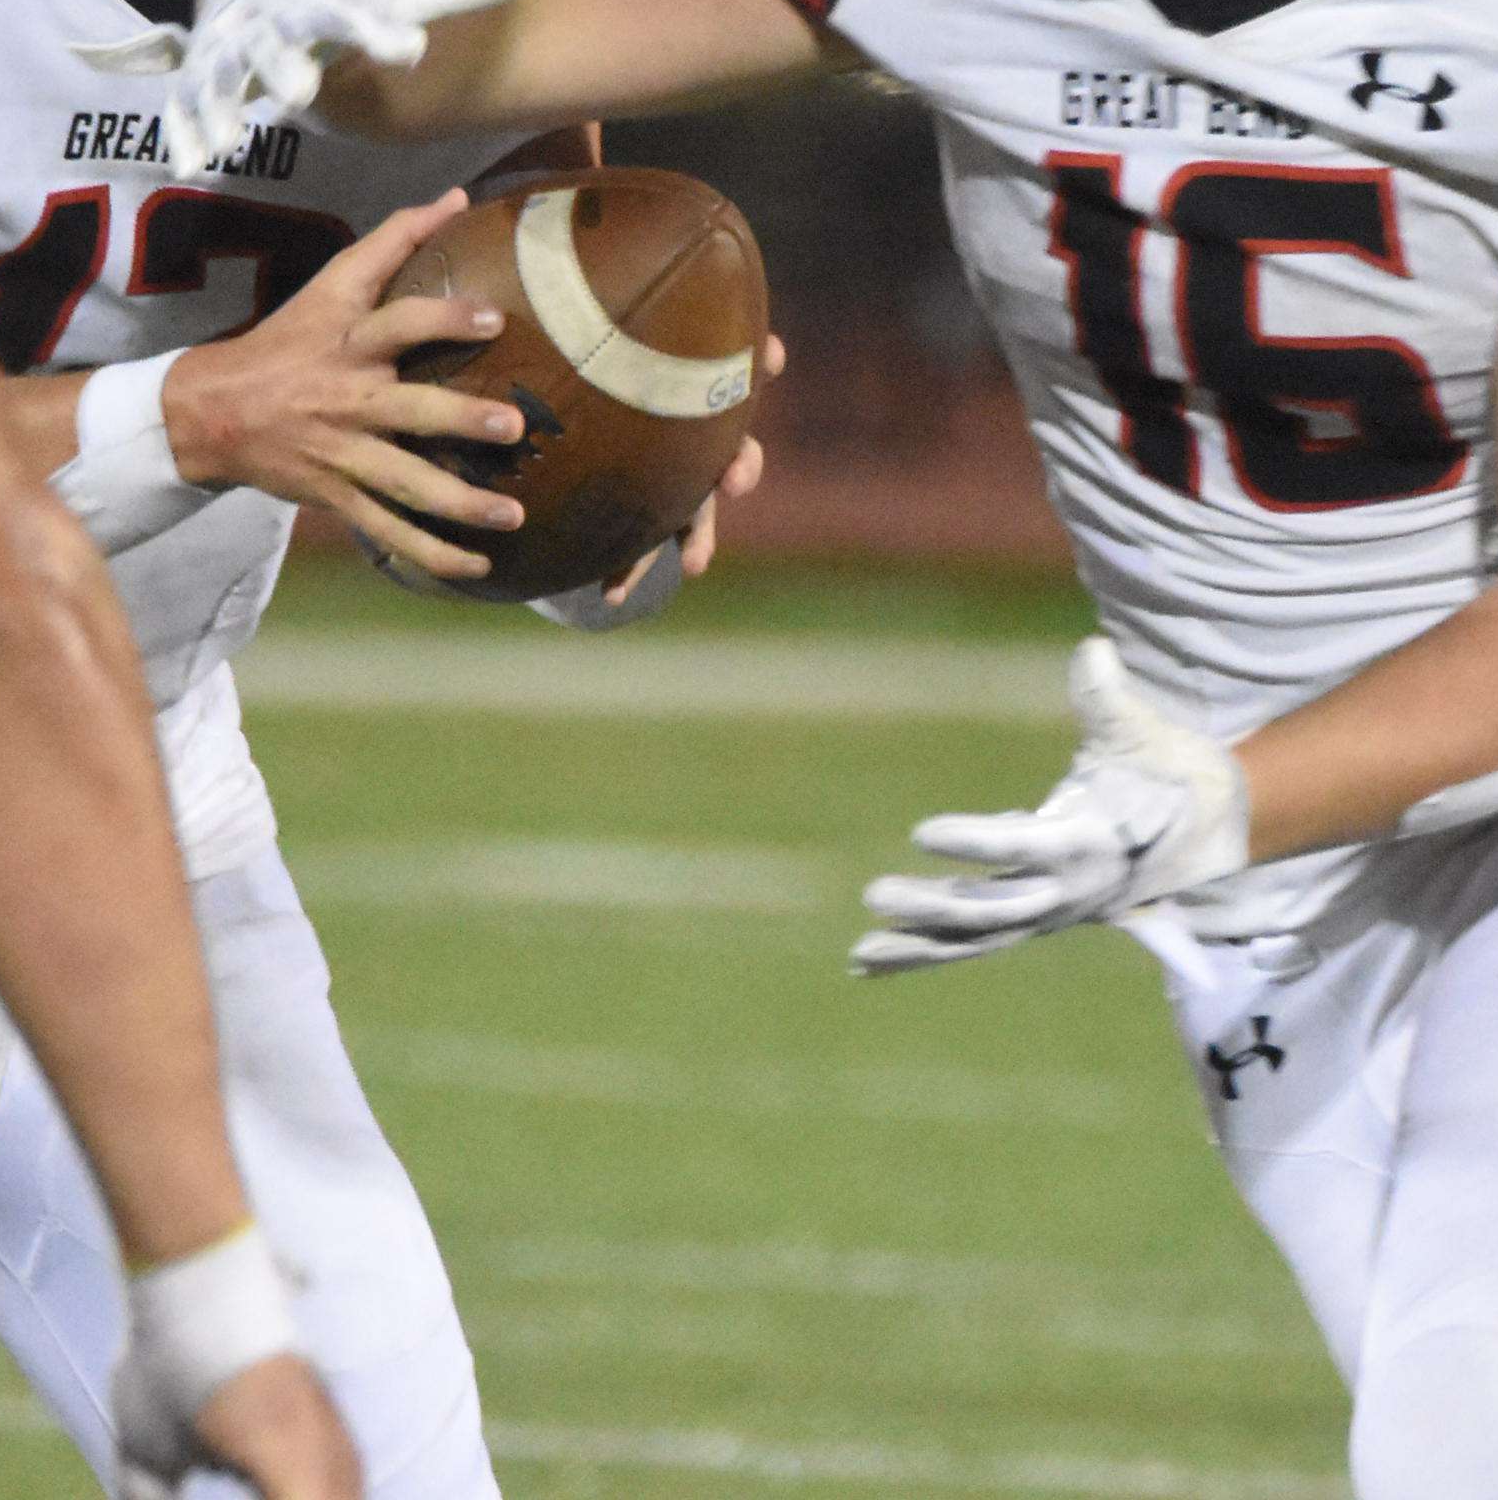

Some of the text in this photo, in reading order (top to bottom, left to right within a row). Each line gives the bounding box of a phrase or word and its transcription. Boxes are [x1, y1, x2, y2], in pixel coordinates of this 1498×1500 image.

[1061, 72, 1183, 130] GREAT
[63, 111, 301, 181] GREA END
[1044, 150, 1470, 514] 16
